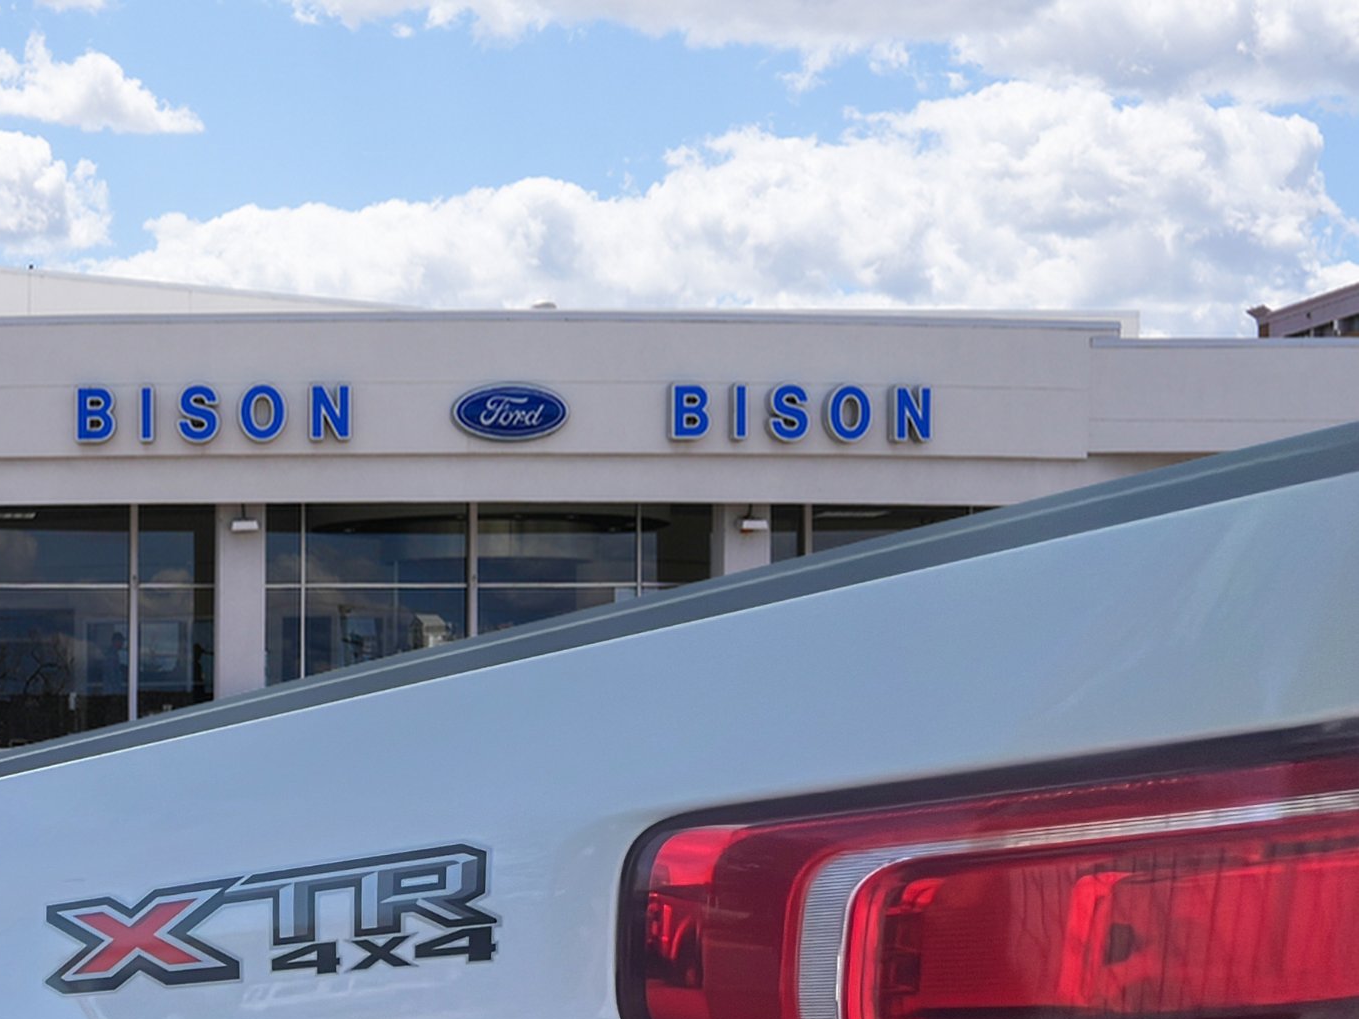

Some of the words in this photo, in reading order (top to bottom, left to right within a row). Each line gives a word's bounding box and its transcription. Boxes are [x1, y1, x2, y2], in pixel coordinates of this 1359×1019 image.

[76, 384, 351, 441] BISON
[480, 396, 544, 426] Ford
[671, 384, 932, 441] BISON
[45, 843, 498, 995] XTR
